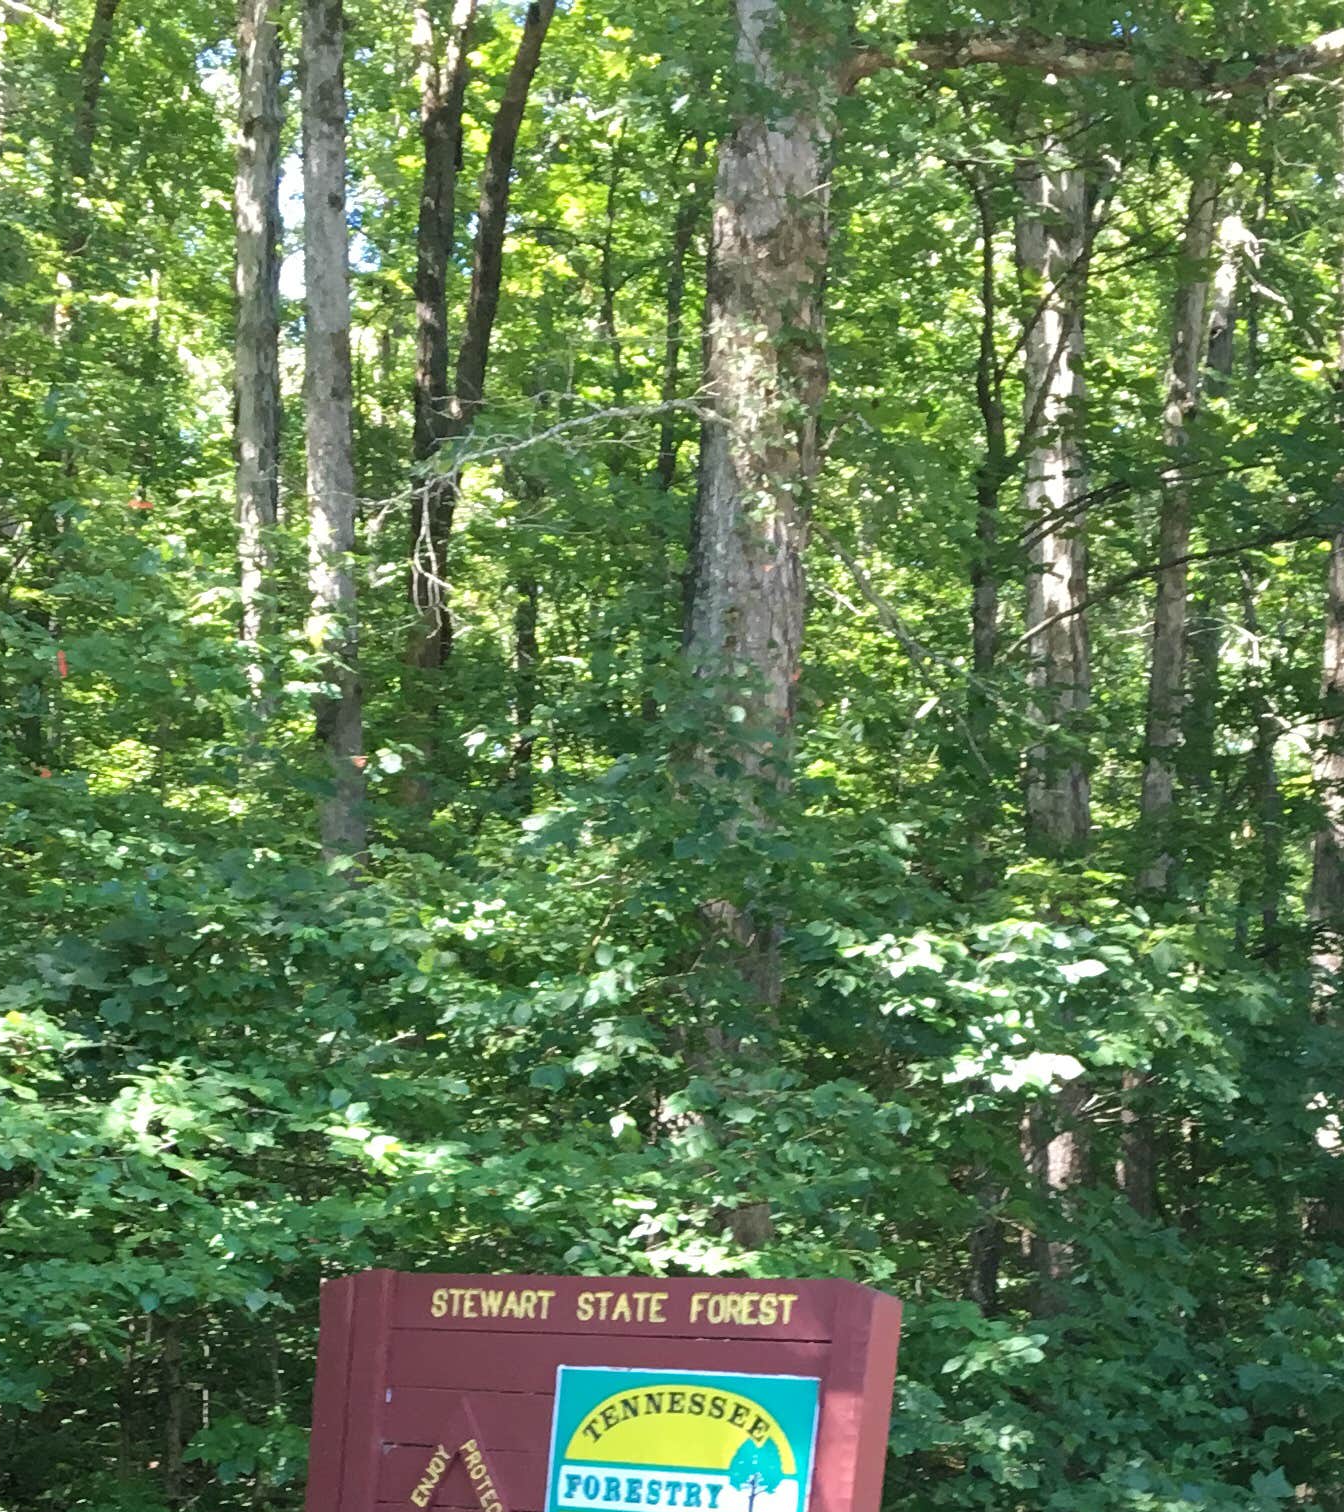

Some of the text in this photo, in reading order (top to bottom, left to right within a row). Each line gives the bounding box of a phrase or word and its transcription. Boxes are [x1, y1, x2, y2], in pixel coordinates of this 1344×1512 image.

[431, 1288, 798, 1325] STEWART STATE FOREST
[582, 1391, 772, 1445] TENNESSEE
[410, 1444, 453, 1509] ENJOY
[564, 1473, 724, 1509] FORESTRY
